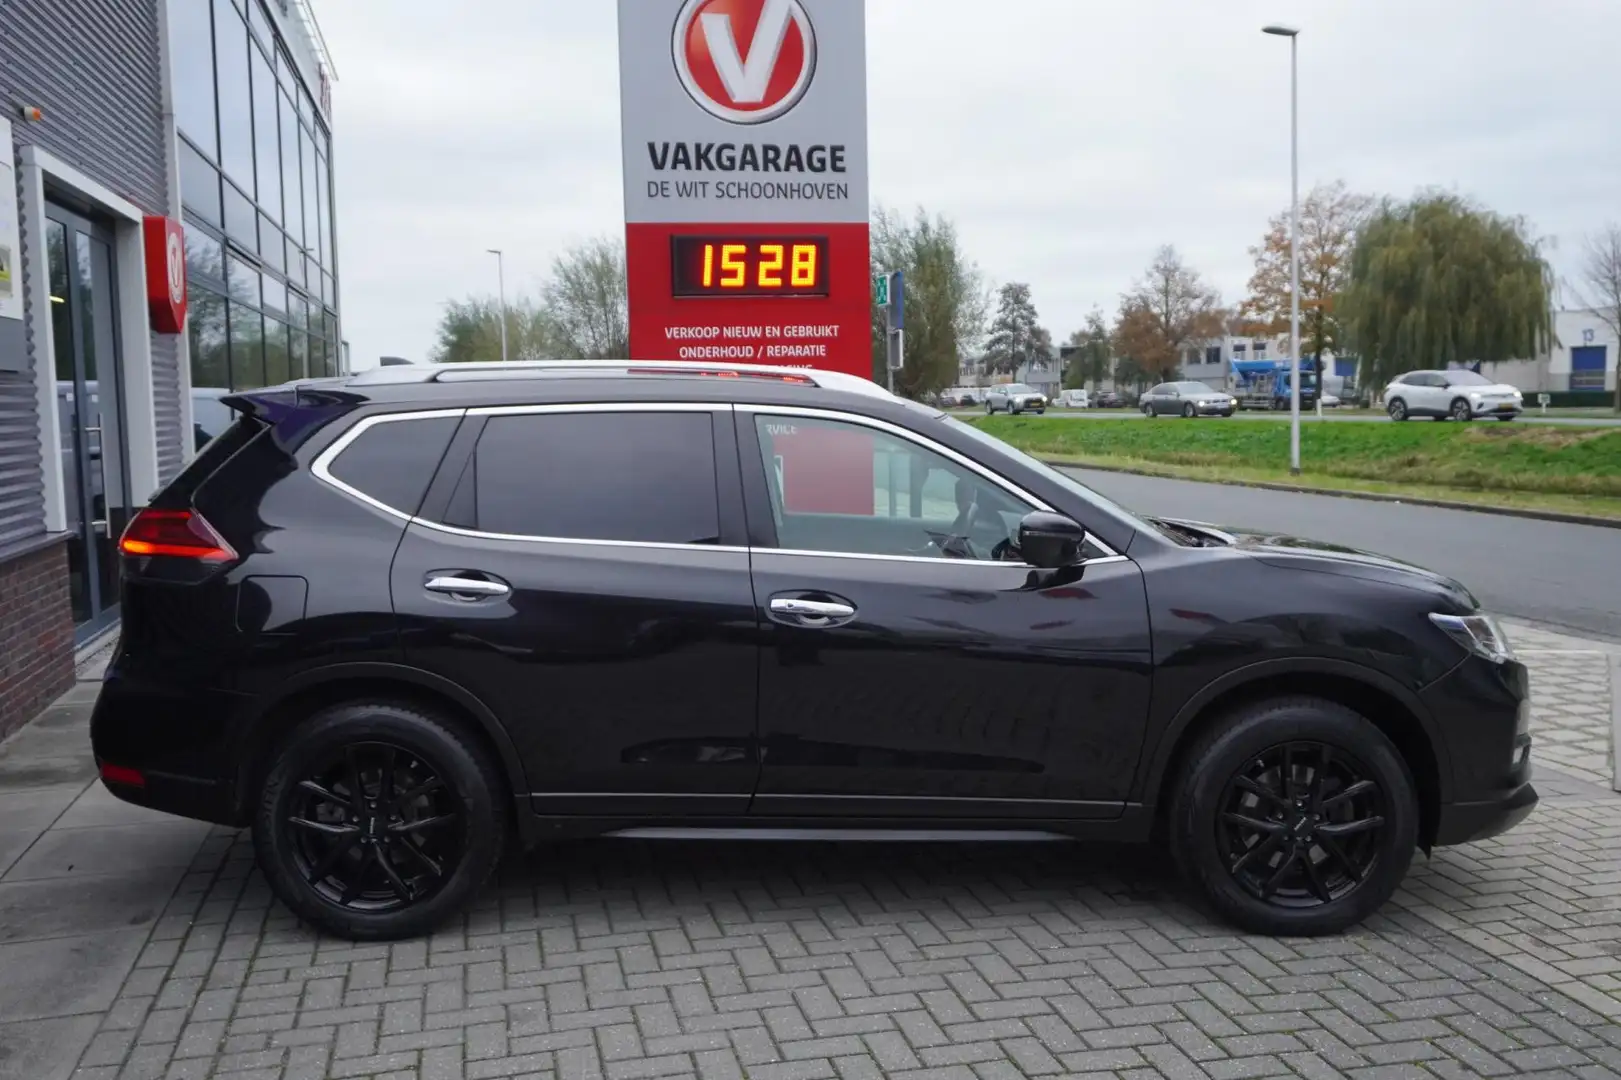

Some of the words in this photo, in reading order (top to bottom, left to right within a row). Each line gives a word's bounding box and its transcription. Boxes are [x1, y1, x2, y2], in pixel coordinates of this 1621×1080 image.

[647, 142, 846, 173] VAKGARAGE
[647, 181, 670, 198] DE
[675, 182, 709, 199] WIT
[715, 182, 848, 200] SCHOONHOVEN
[665, 326, 720, 339] VERKOOP
[723, 326, 762, 338] NIEUW
[766, 325, 781, 337] EN
[784, 325, 840, 337] GEBRUIKT
[679, 346, 754, 358] ONDERHOUD
[767, 345, 826, 357] REPARATIE
